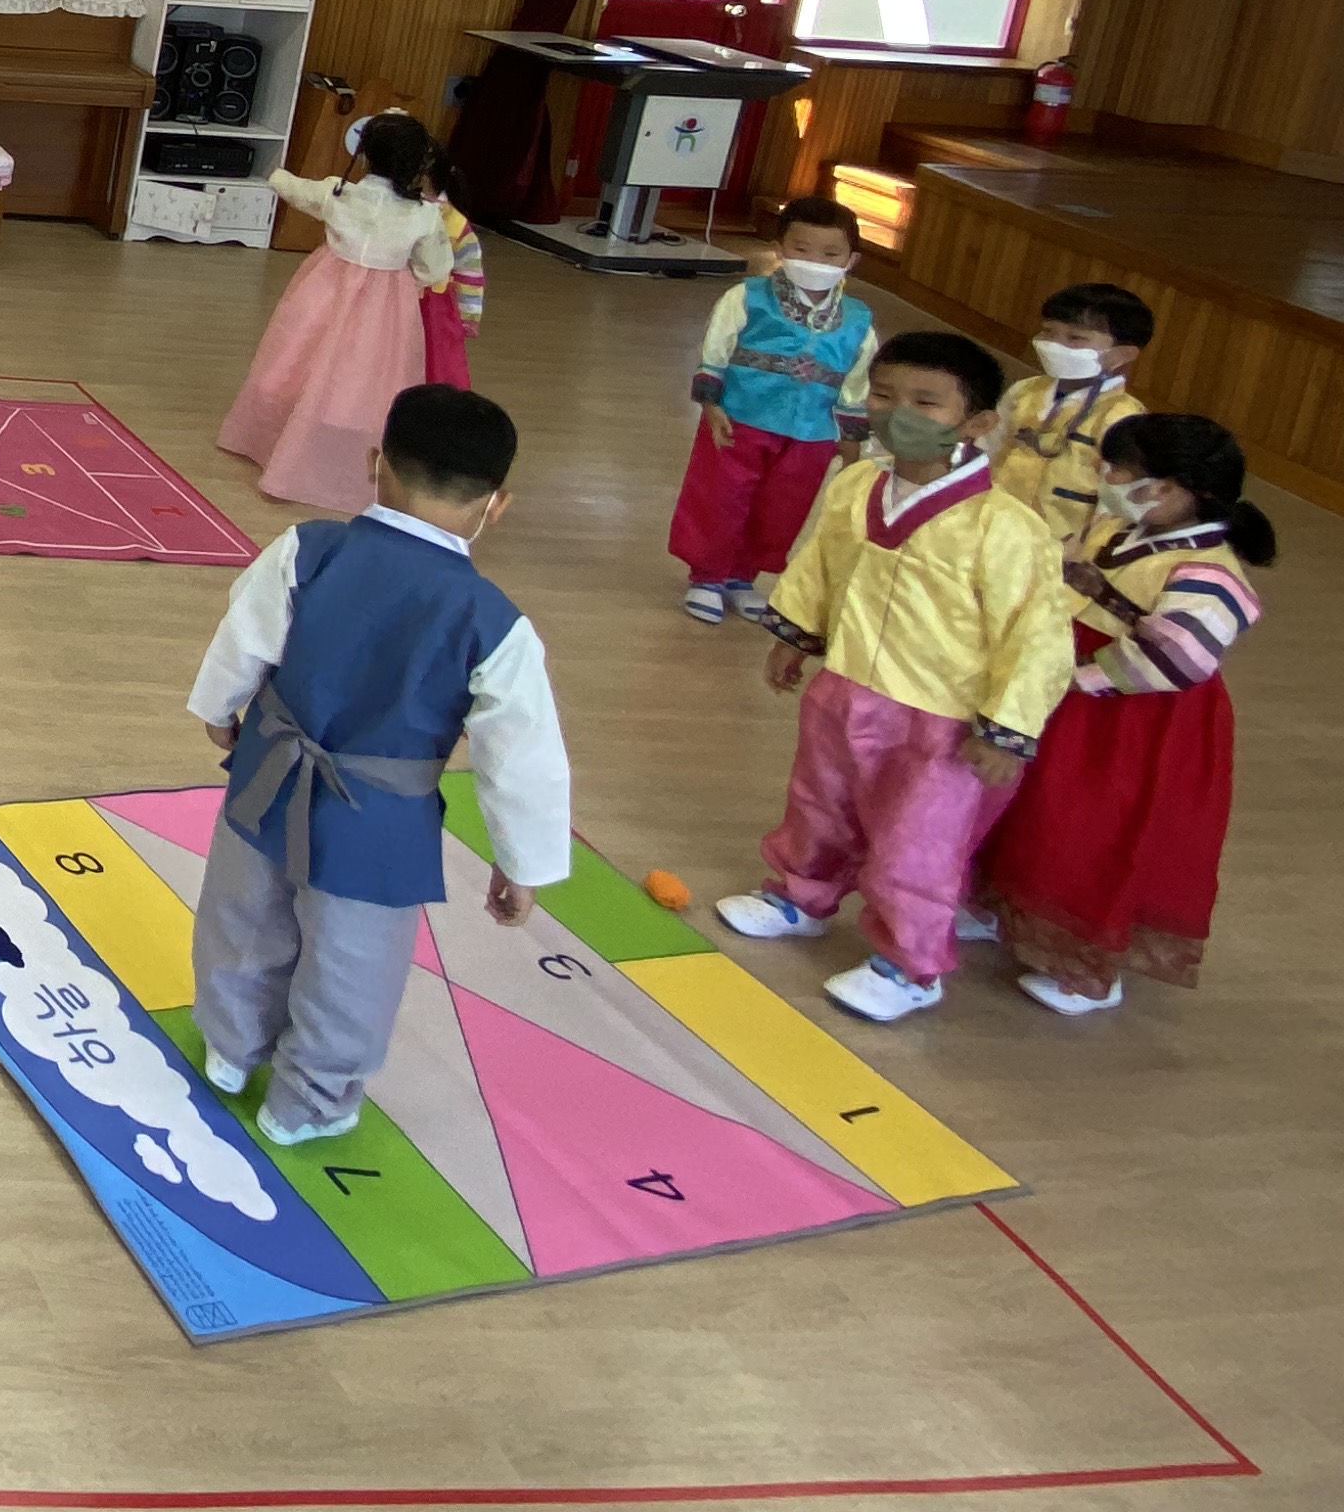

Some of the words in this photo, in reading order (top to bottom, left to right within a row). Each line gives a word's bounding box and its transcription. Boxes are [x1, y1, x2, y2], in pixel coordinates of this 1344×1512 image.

[20, 464, 55, 476] 3
[55, 852, 104, 875] 8
[538, 953, 593, 980] 3
[33, 983, 116, 1069] 하늘
[839, 1106, 881, 1124] 1
[322, 1165, 381, 1196] 7
[625, 1169, 686, 1201] 4
